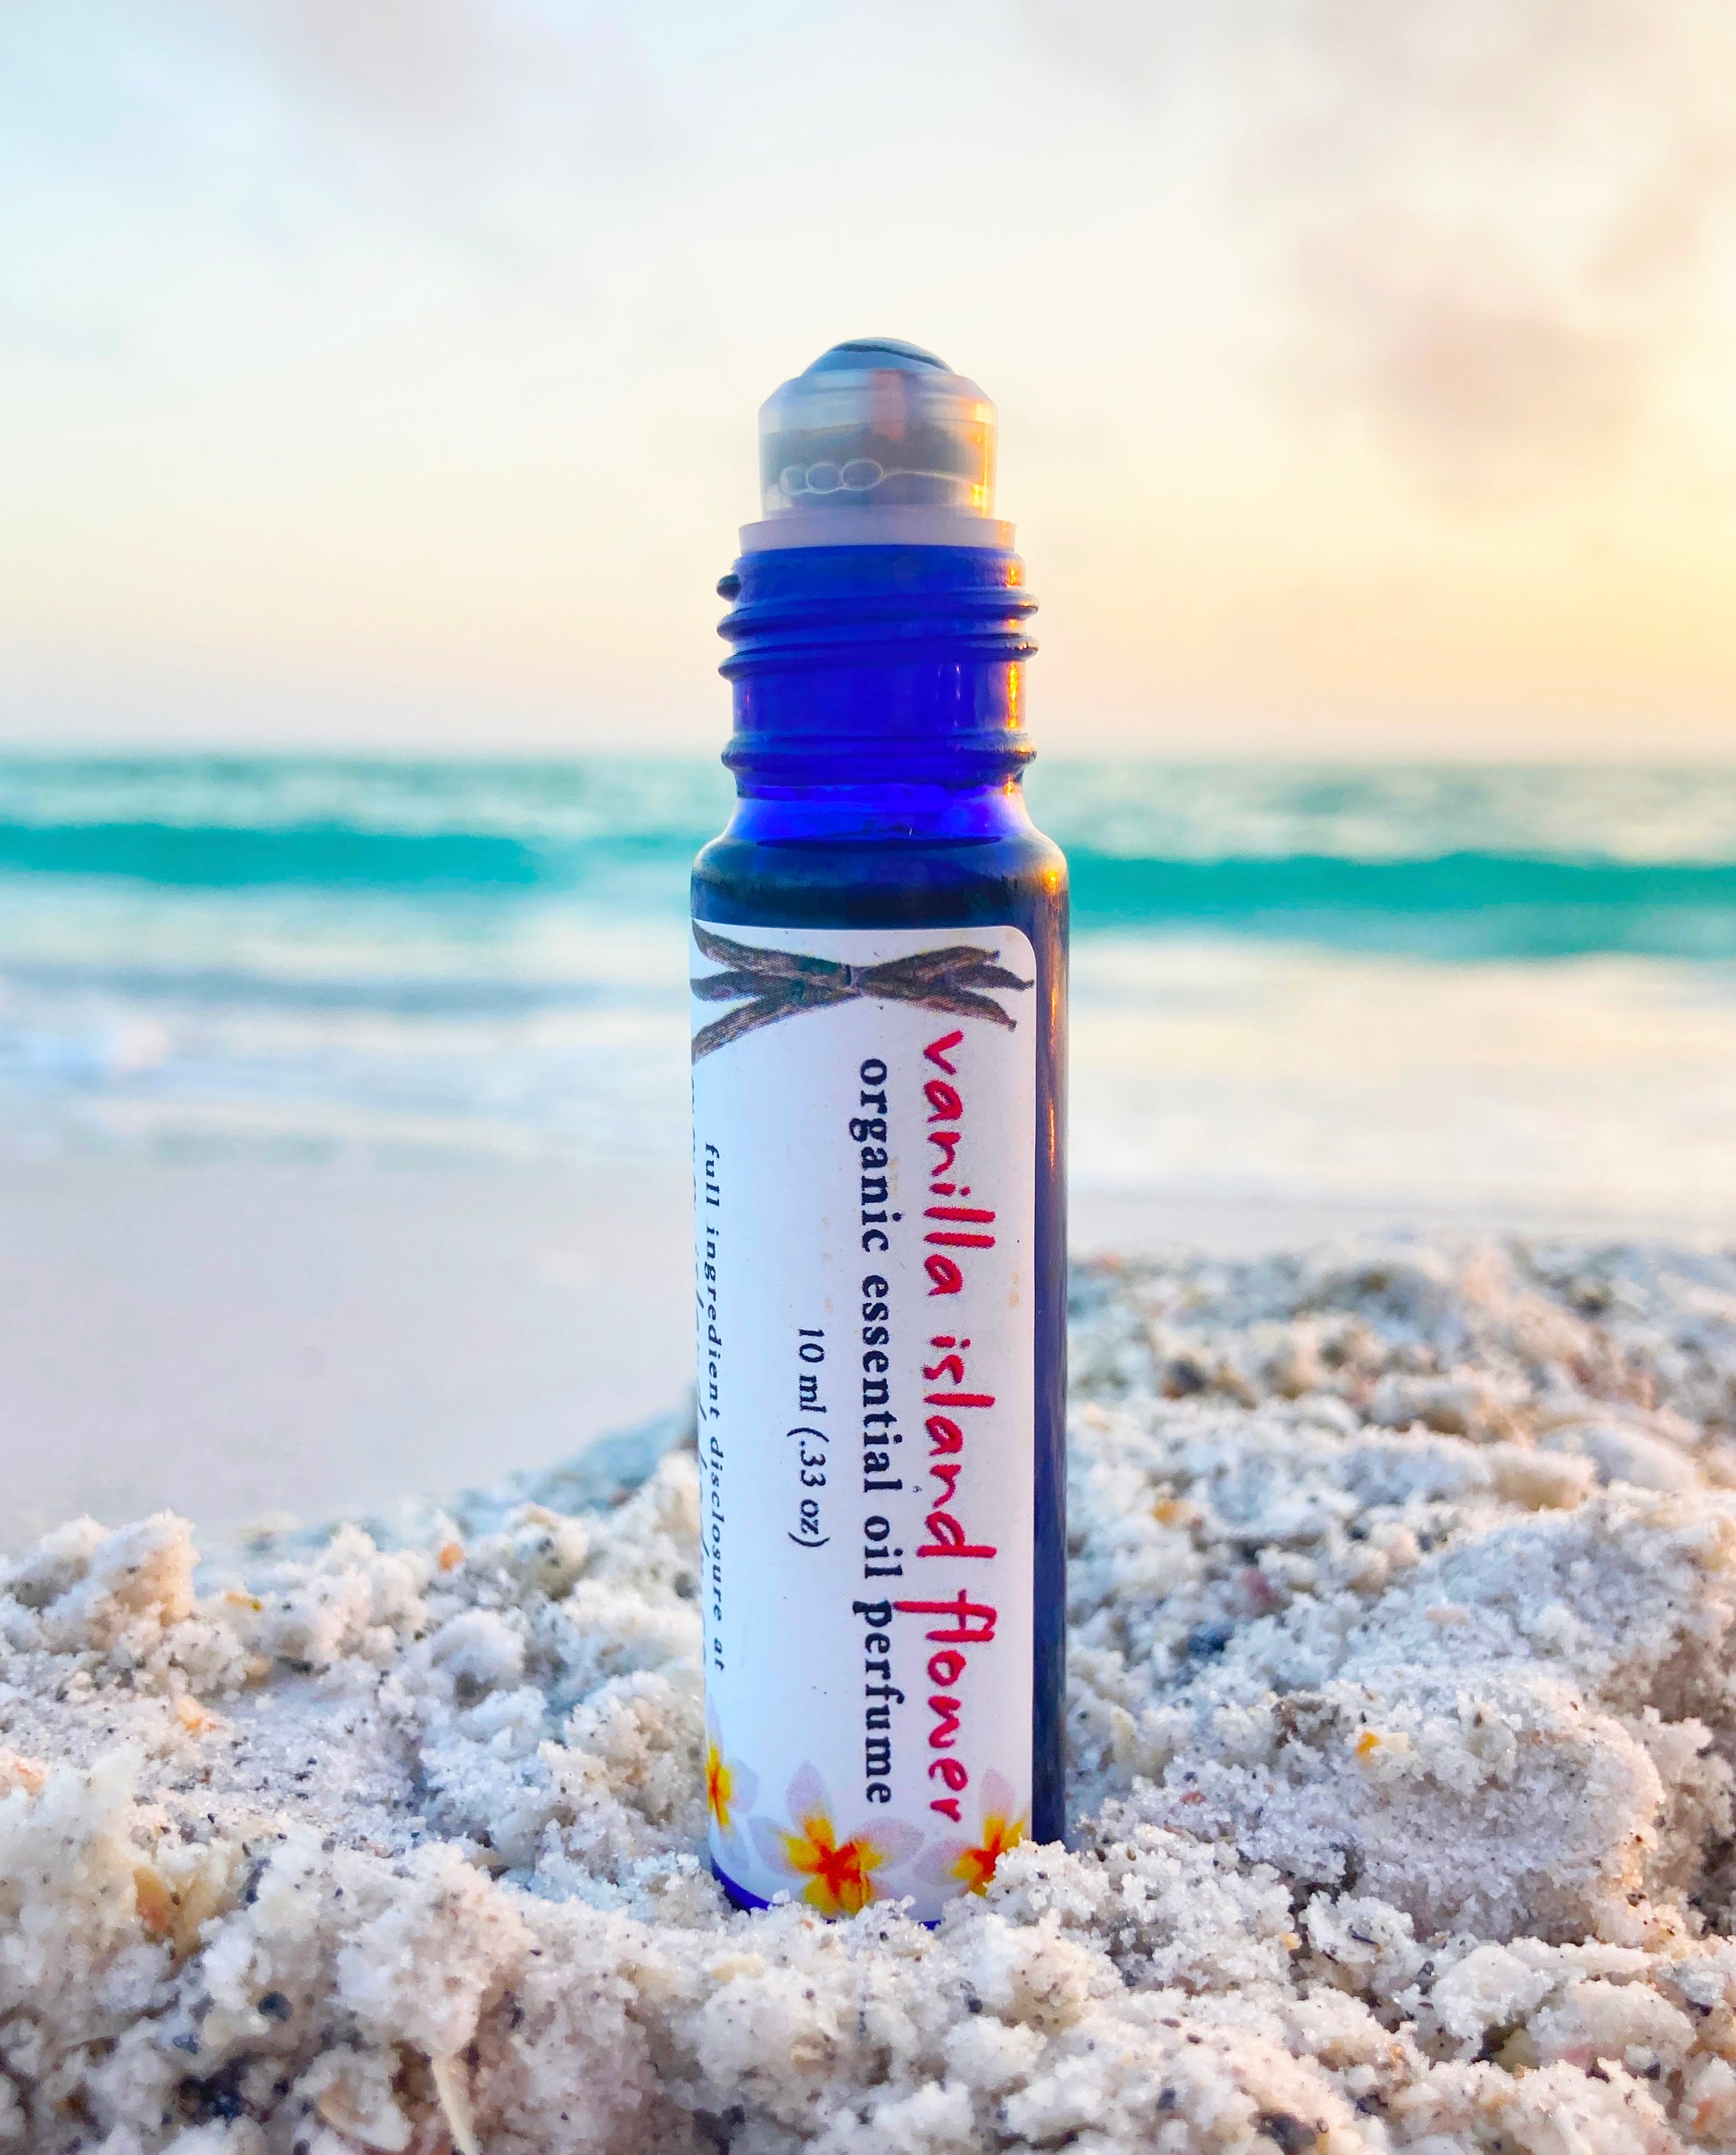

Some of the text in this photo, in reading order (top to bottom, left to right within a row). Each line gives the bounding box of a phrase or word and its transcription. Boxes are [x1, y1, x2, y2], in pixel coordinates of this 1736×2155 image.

[706, 1142, 724, 1670] full ingredient disclosure at
[787, 1329, 830, 1547] 10 ml (.33 oz)
[849, 1058, 905, 1803] organic essential oil perfume
[894, 1030, 998, 1824] vanilla island flower
